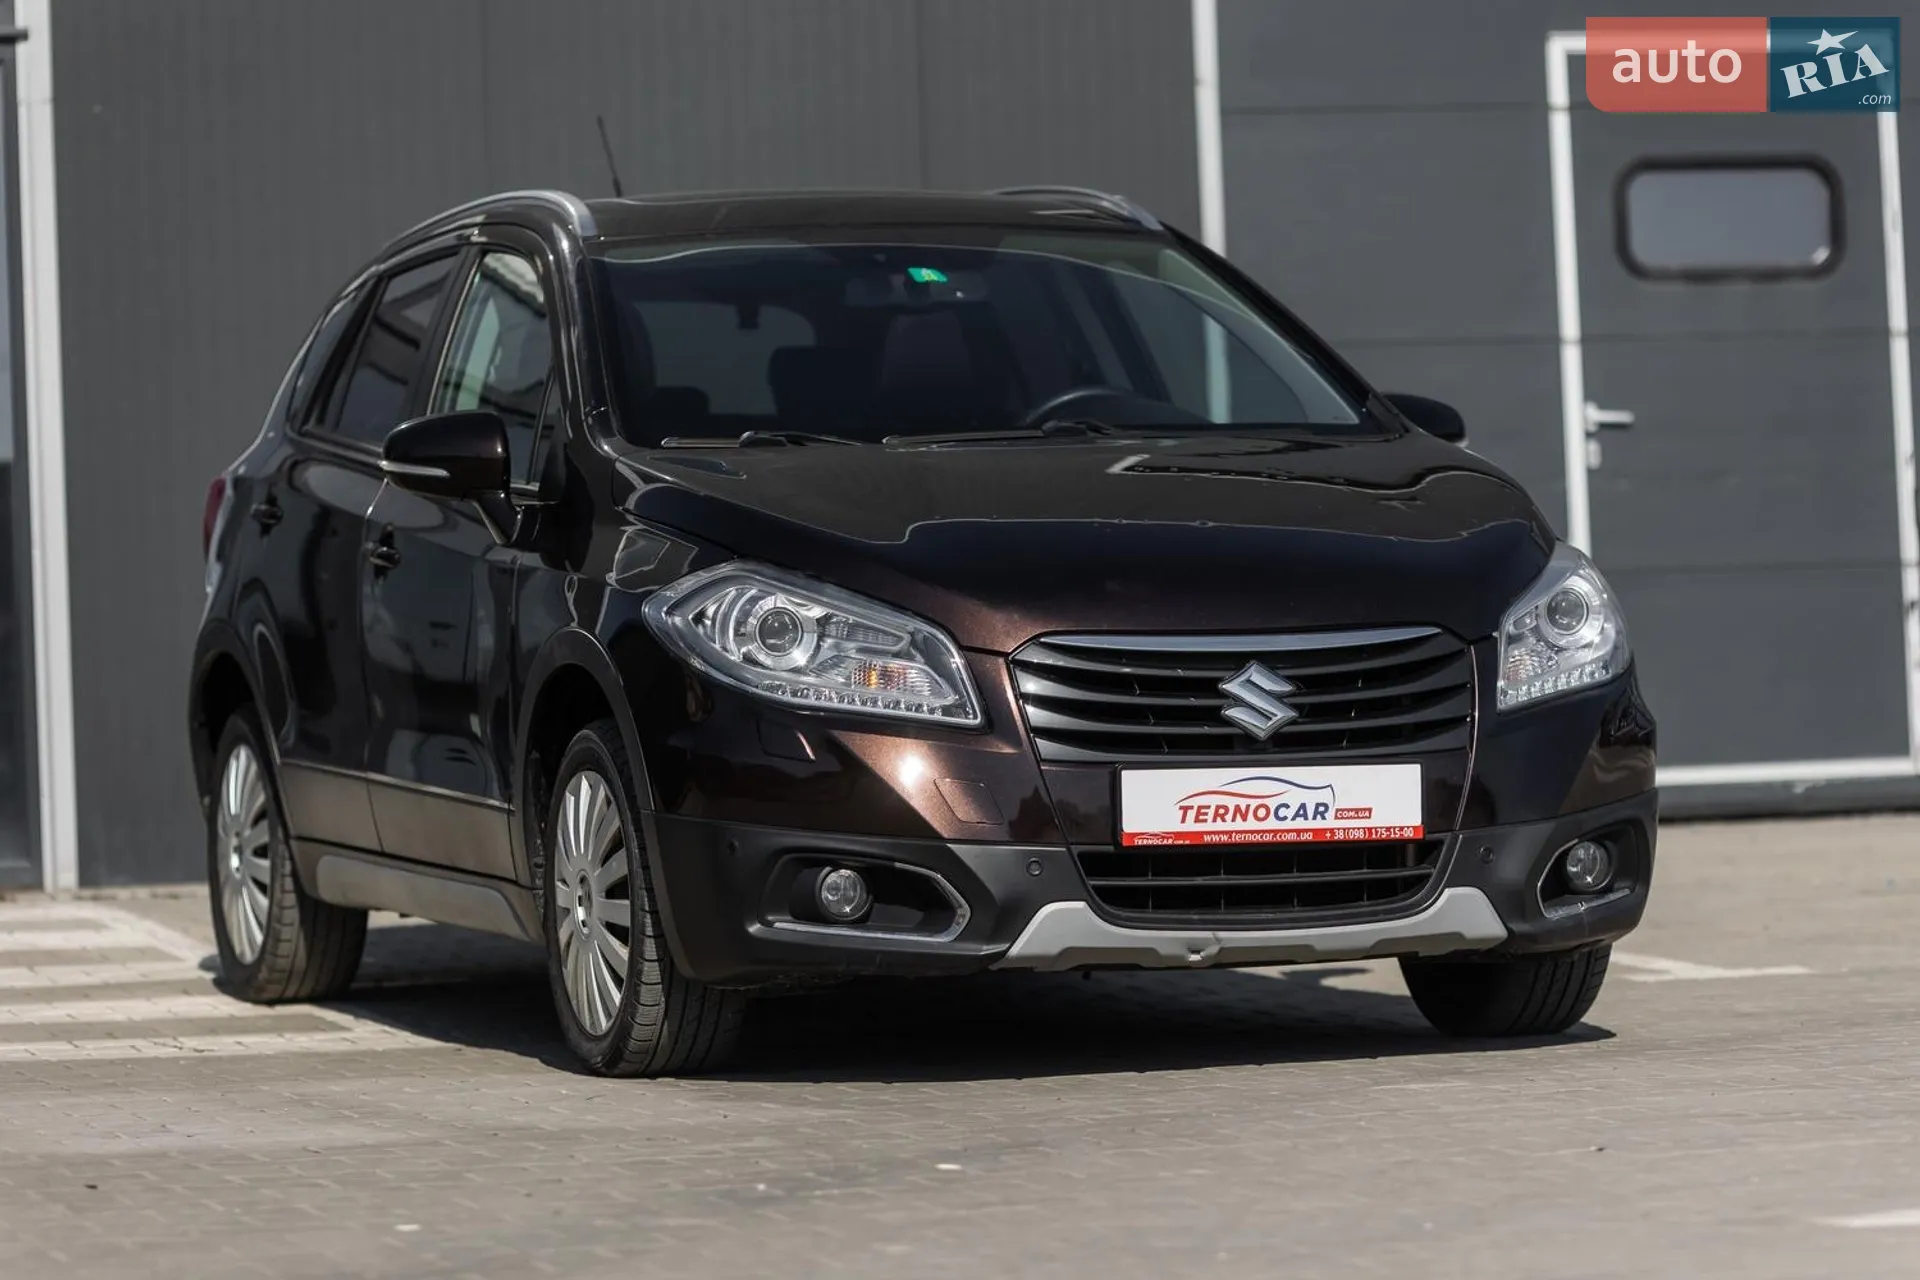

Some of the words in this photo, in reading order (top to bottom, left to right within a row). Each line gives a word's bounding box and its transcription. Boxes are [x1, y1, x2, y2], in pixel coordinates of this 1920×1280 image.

[1178, 802, 1330, 824] TERNOCAR
[1336, 810, 1371, 818] COM.UA
[1203, 831, 1313, 843] www.ternocar.com.ua
[1333, 828, 1369, 840] 38(098)
[1371, 827, 1415, 839] 175-15-00
